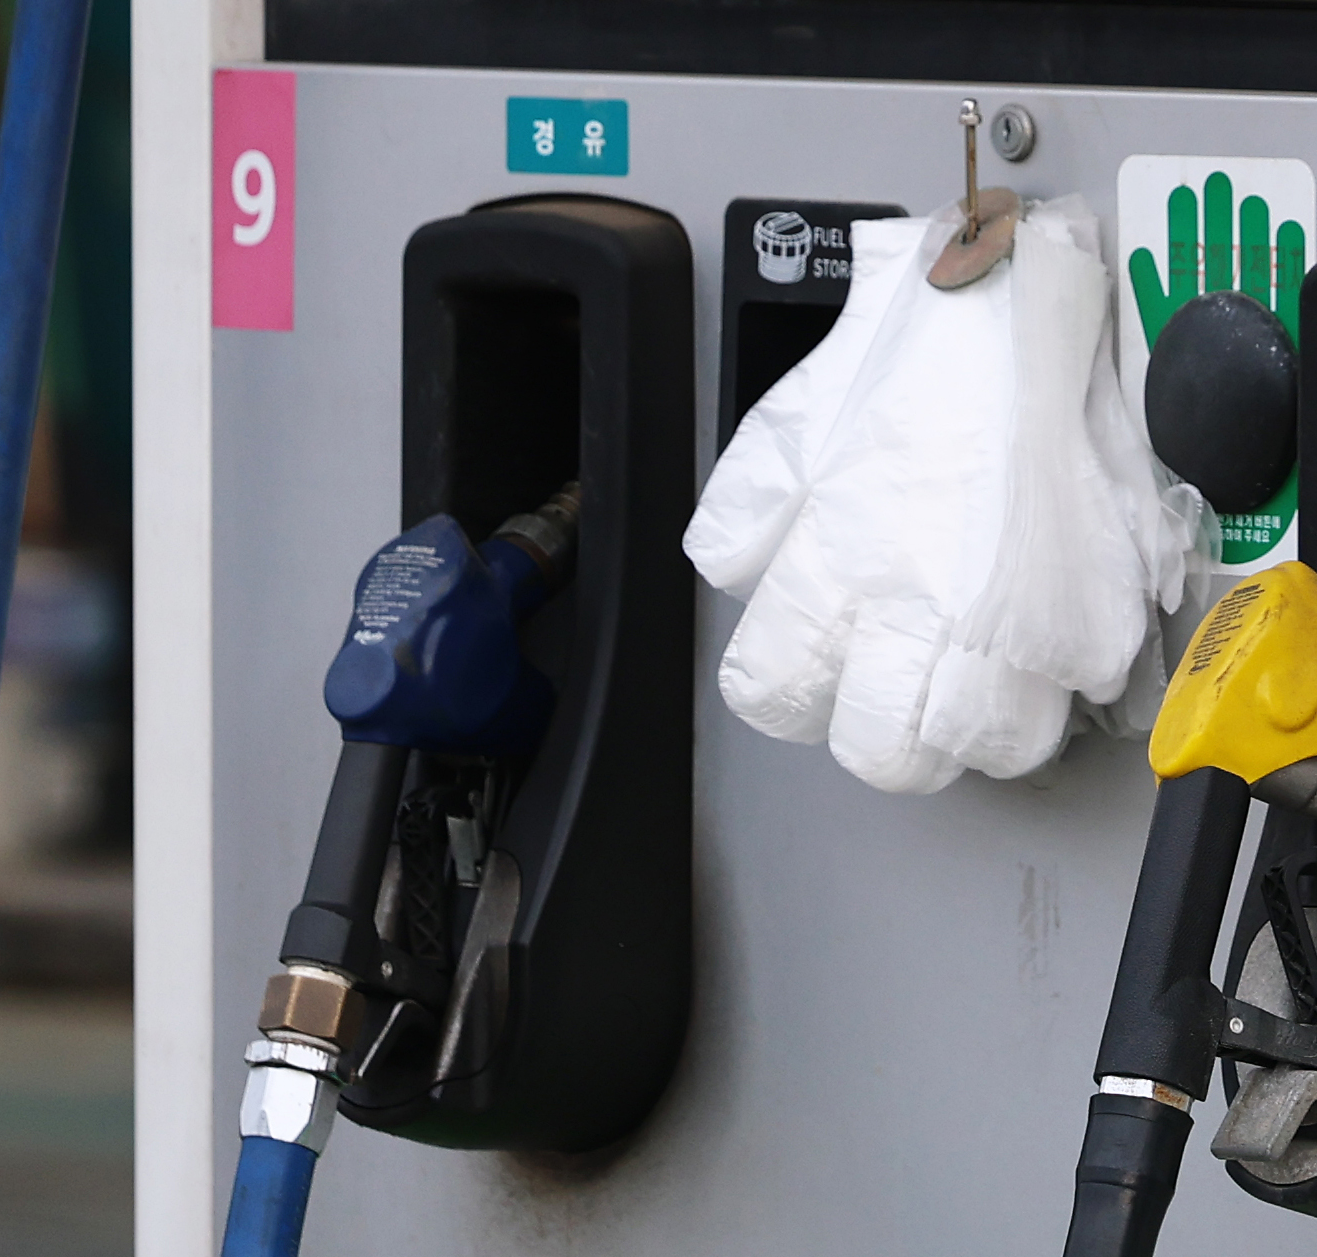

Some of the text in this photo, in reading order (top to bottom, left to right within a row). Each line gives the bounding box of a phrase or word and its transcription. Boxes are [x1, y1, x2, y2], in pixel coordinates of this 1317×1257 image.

[231, 150, 276, 245] 9
[813, 226, 847, 248] FUEL
[813, 257, 850, 279] STOR
[1244, 529, 1270, 543] 주세요
